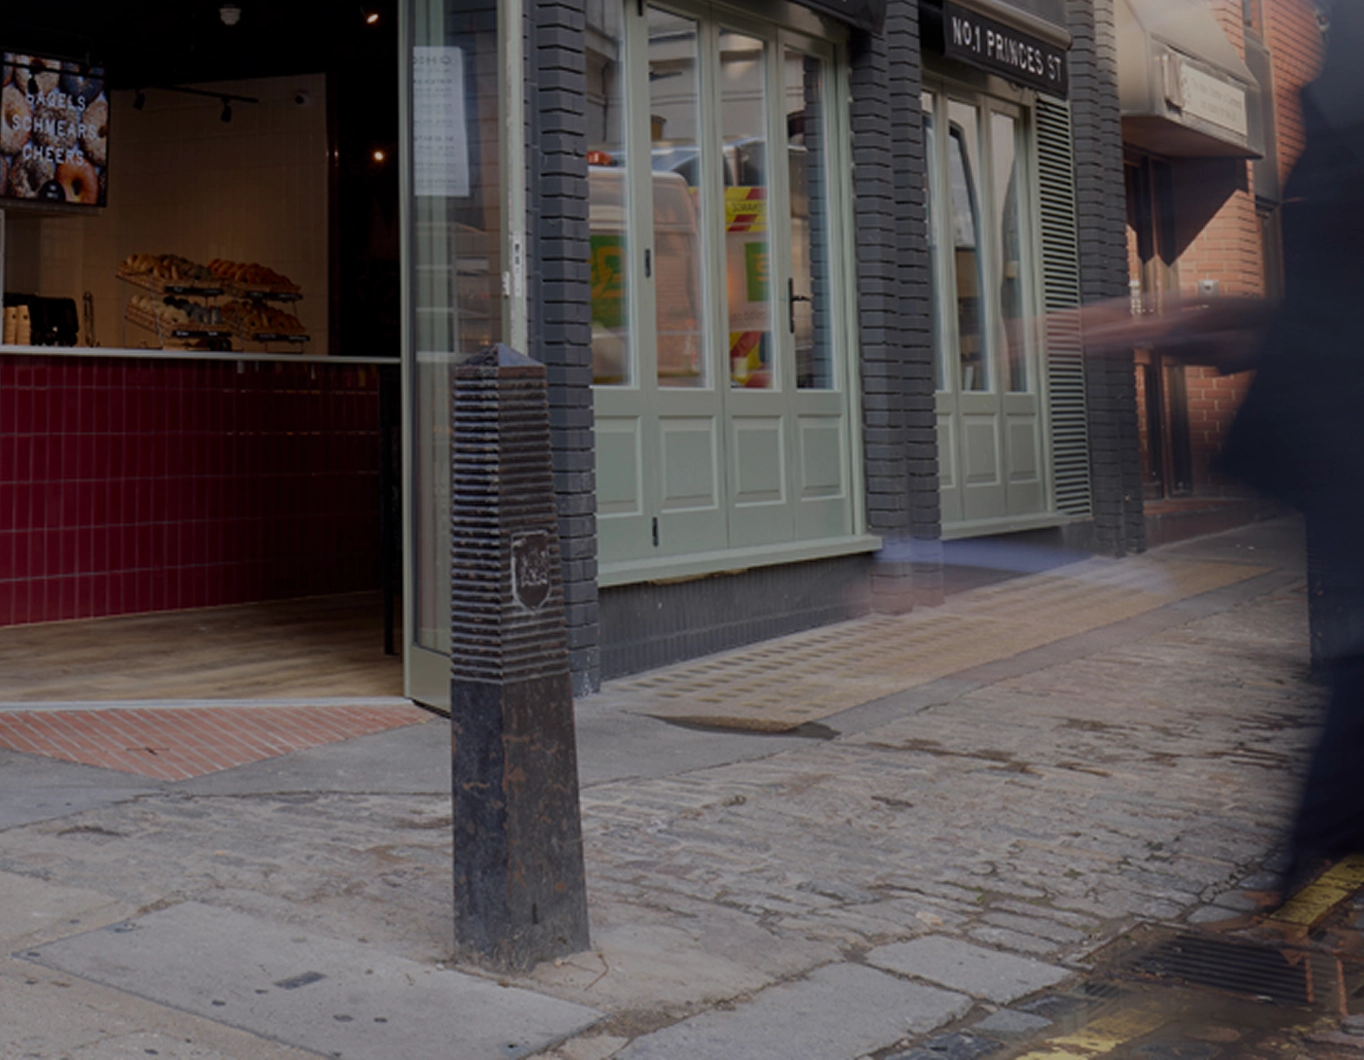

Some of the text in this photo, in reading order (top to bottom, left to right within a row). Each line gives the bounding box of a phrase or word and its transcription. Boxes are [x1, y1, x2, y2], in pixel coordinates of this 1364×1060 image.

[951, 16, 1062, 83] NO.1 PRINCES ST
